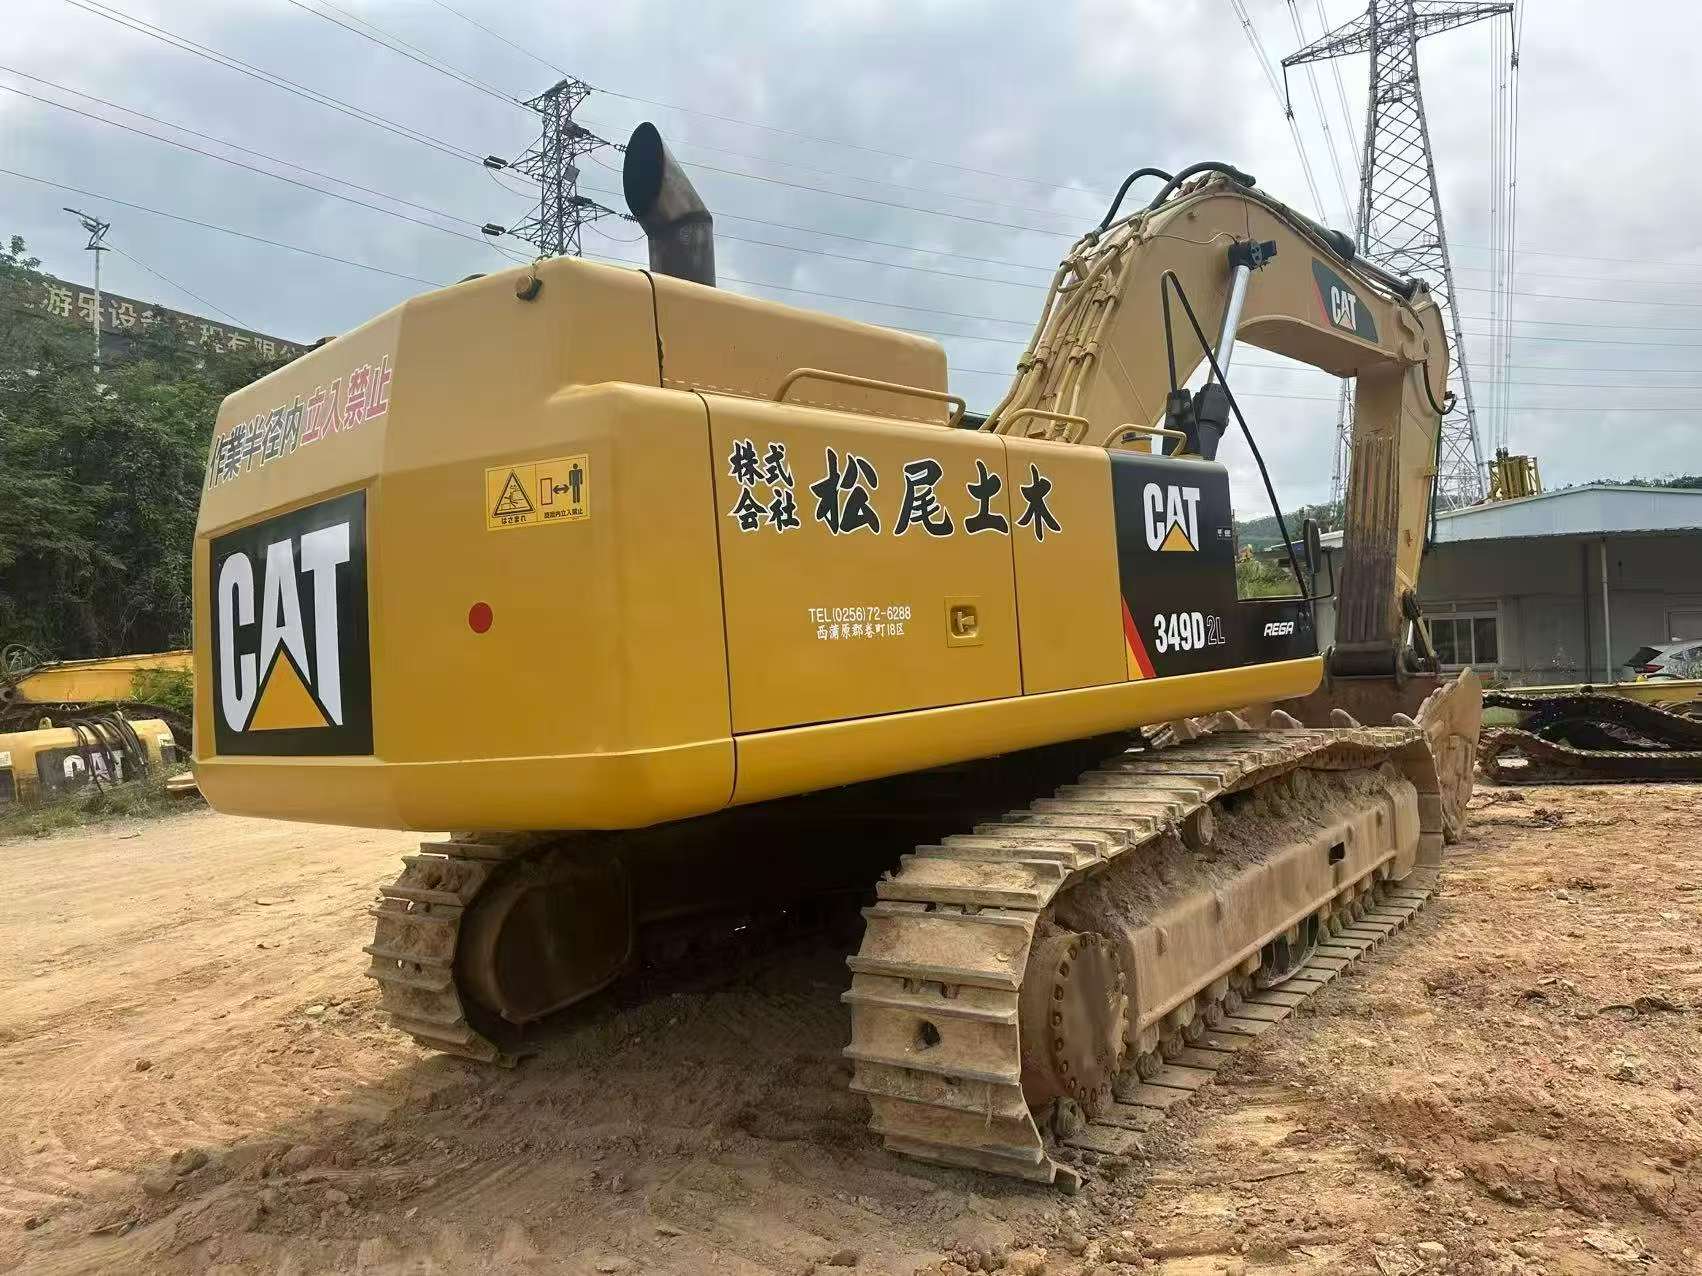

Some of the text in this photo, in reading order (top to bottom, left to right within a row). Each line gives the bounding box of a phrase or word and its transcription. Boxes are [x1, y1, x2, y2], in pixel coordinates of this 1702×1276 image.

[1330, 285, 1357, 331] CAT
[728, 439, 794, 488] 株式
[727, 486, 802, 534] 会社
[808, 447, 1062, 543] 松尾土木
[1143, 482, 1200, 552] CAT
[218, 521, 351, 733] CAT
